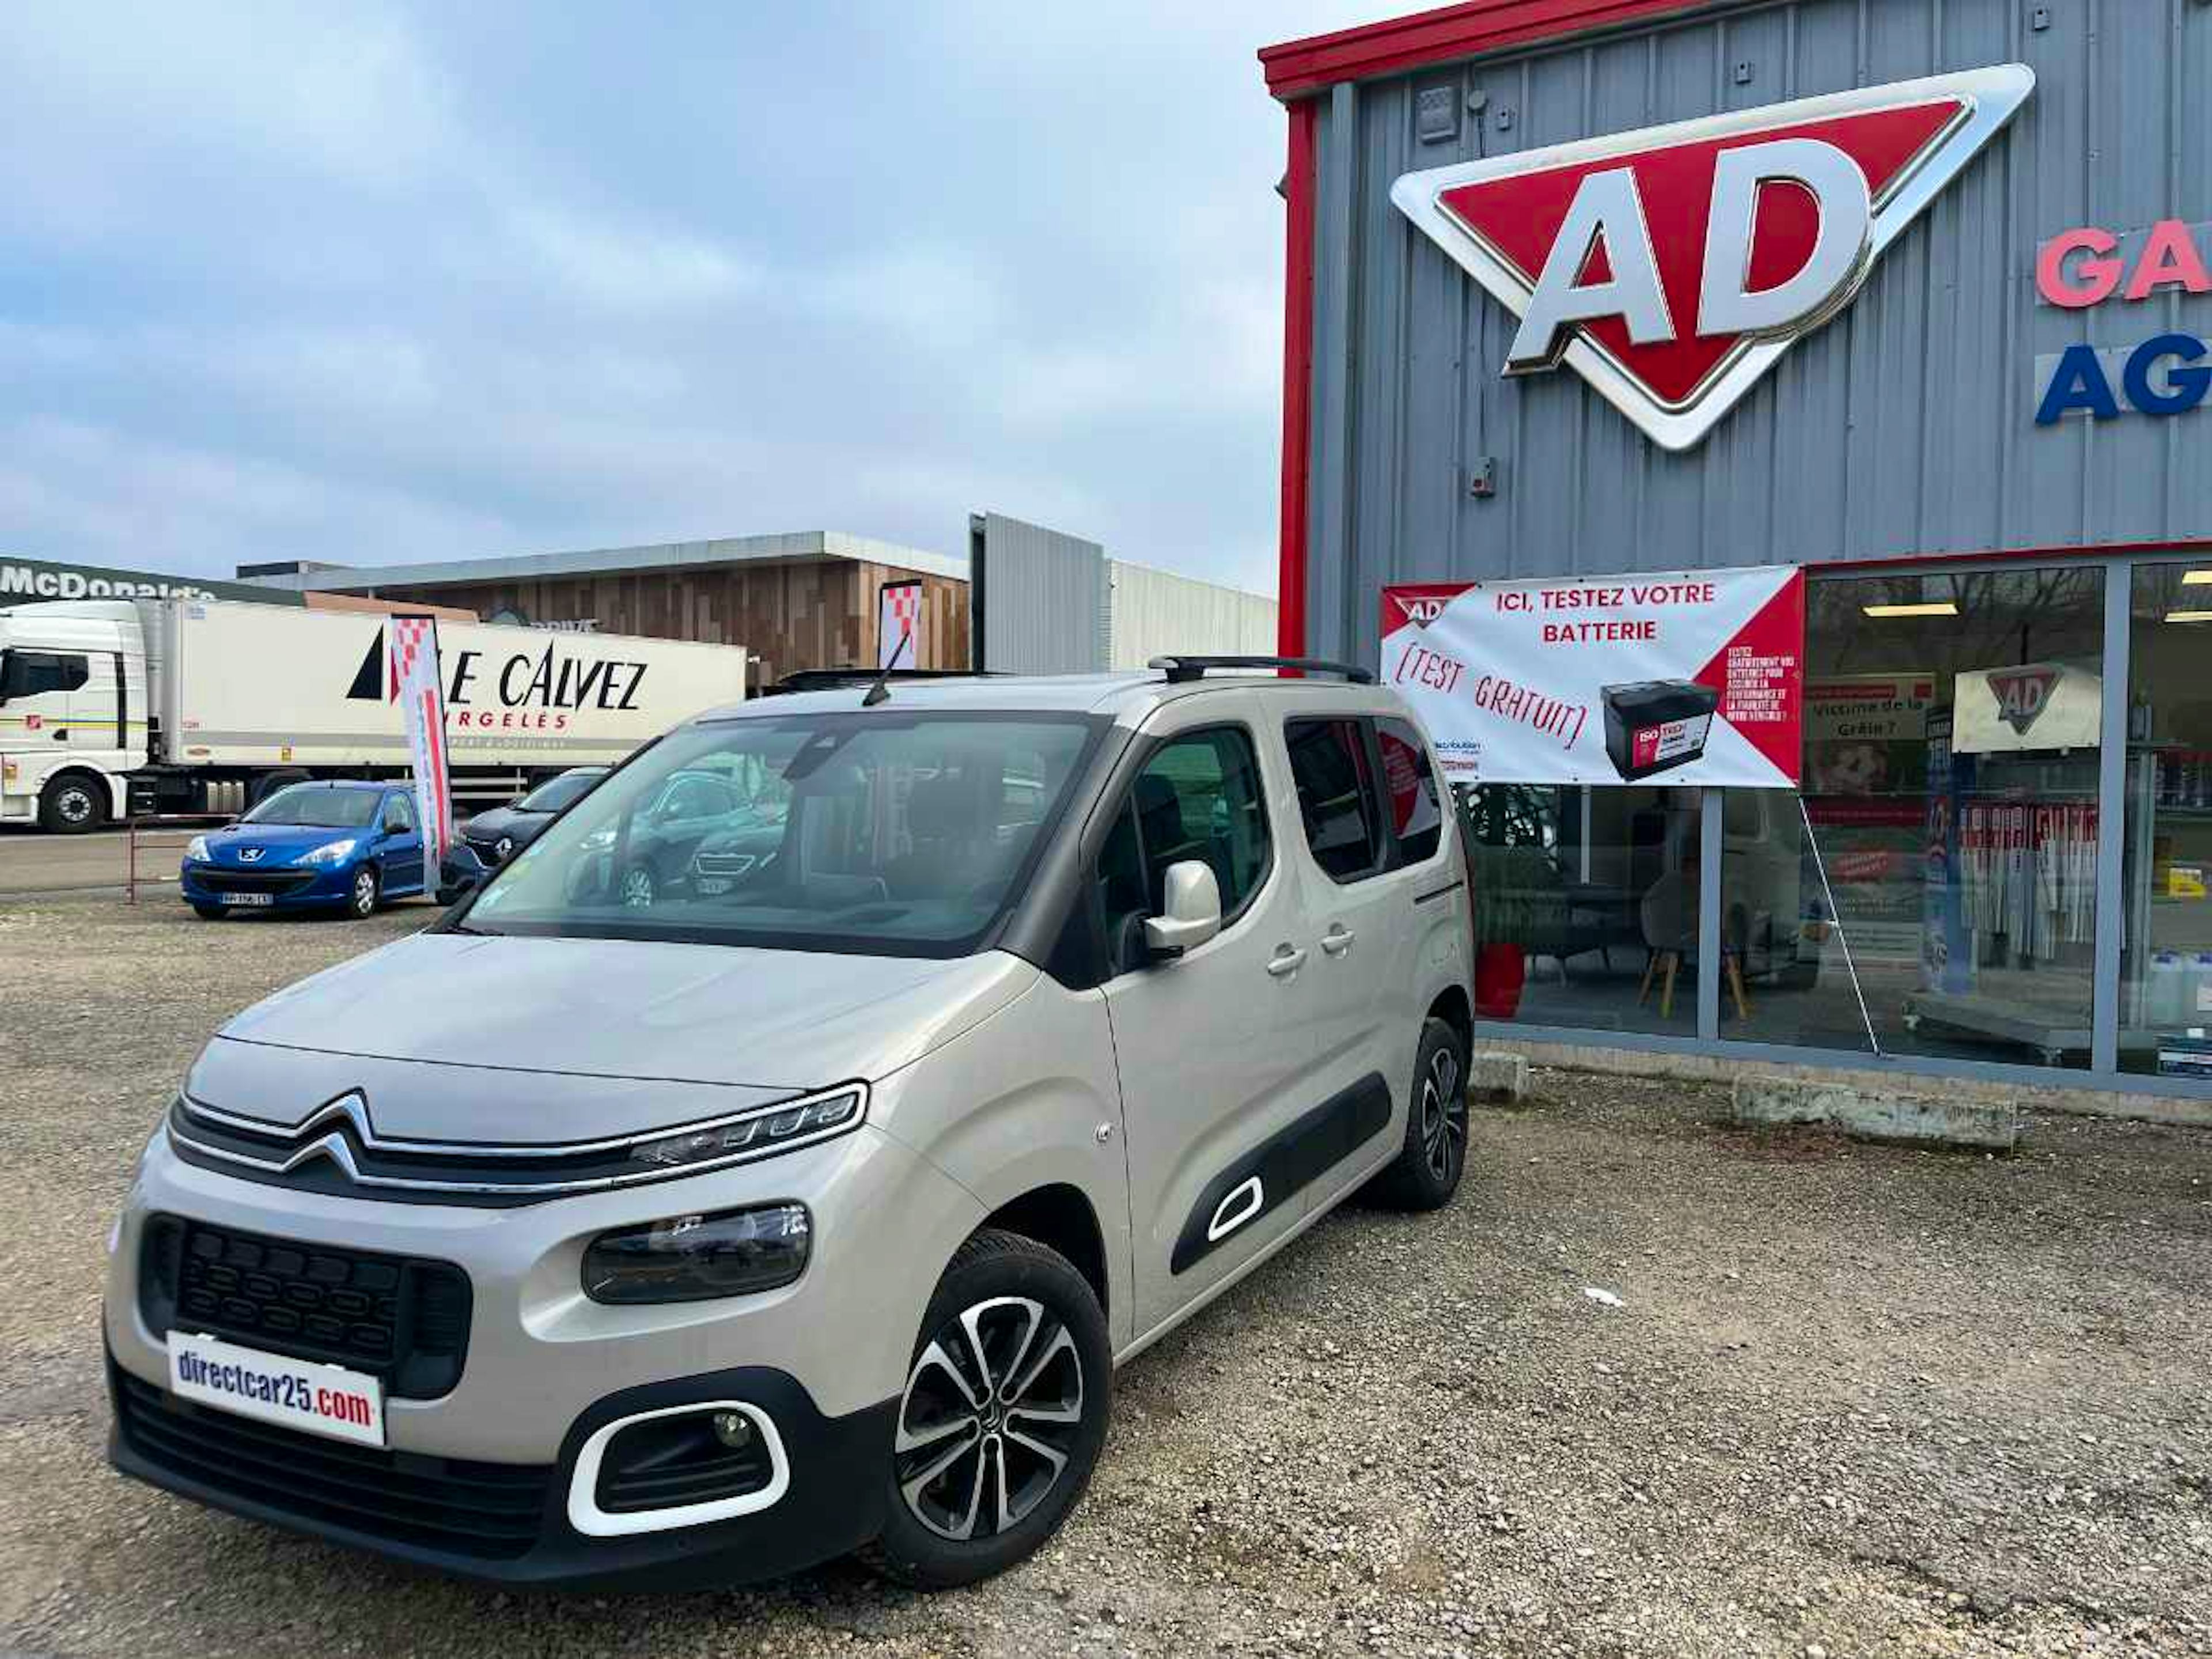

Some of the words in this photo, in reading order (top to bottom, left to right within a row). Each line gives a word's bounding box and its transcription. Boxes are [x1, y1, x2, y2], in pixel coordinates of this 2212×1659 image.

[1502, 138, 1877, 376] AD
[1407, 601, 1442, 621] AD
[1496, 592, 1533, 612] ICI,
[1541, 588, 1623, 609] TESTEZ
[1629, 584, 1715, 605] VOTRE
[1543, 620, 1657, 642] BATTERIE
[499, 637, 648, 711] CALVEZ
[1999, 677, 2046, 721] AD
[177, 1350, 372, 1427] directcar25.com
